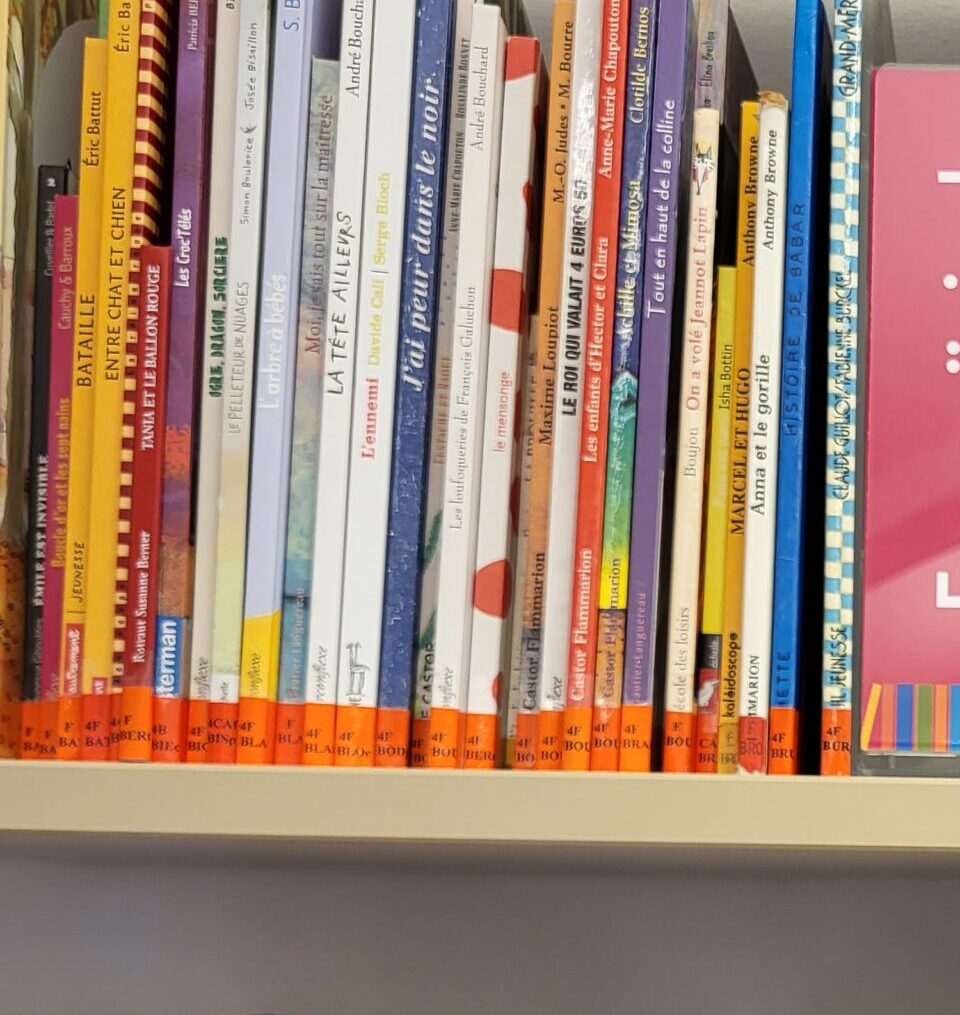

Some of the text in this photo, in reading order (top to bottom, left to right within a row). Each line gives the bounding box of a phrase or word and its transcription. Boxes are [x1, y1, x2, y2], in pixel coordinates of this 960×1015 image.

[106, 187, 127, 381] ENTRE CHAT ET CHIEN
[402, 77, 439, 392] J'ai peur dans le noir
[647, 99, 676, 319] Tout en haut de la colline
[79, 294, 96, 388] BATAILLE
[562, 205, 587, 416] LE ROI QUI VALAIT 4 EUROS
[751, 353, 773, 516] Anna et le gorille
[572, 548, 593, 701] Castor Flammarion
[823, 742, 850, 752] BUR
[826, 726, 842, 736] 4F
